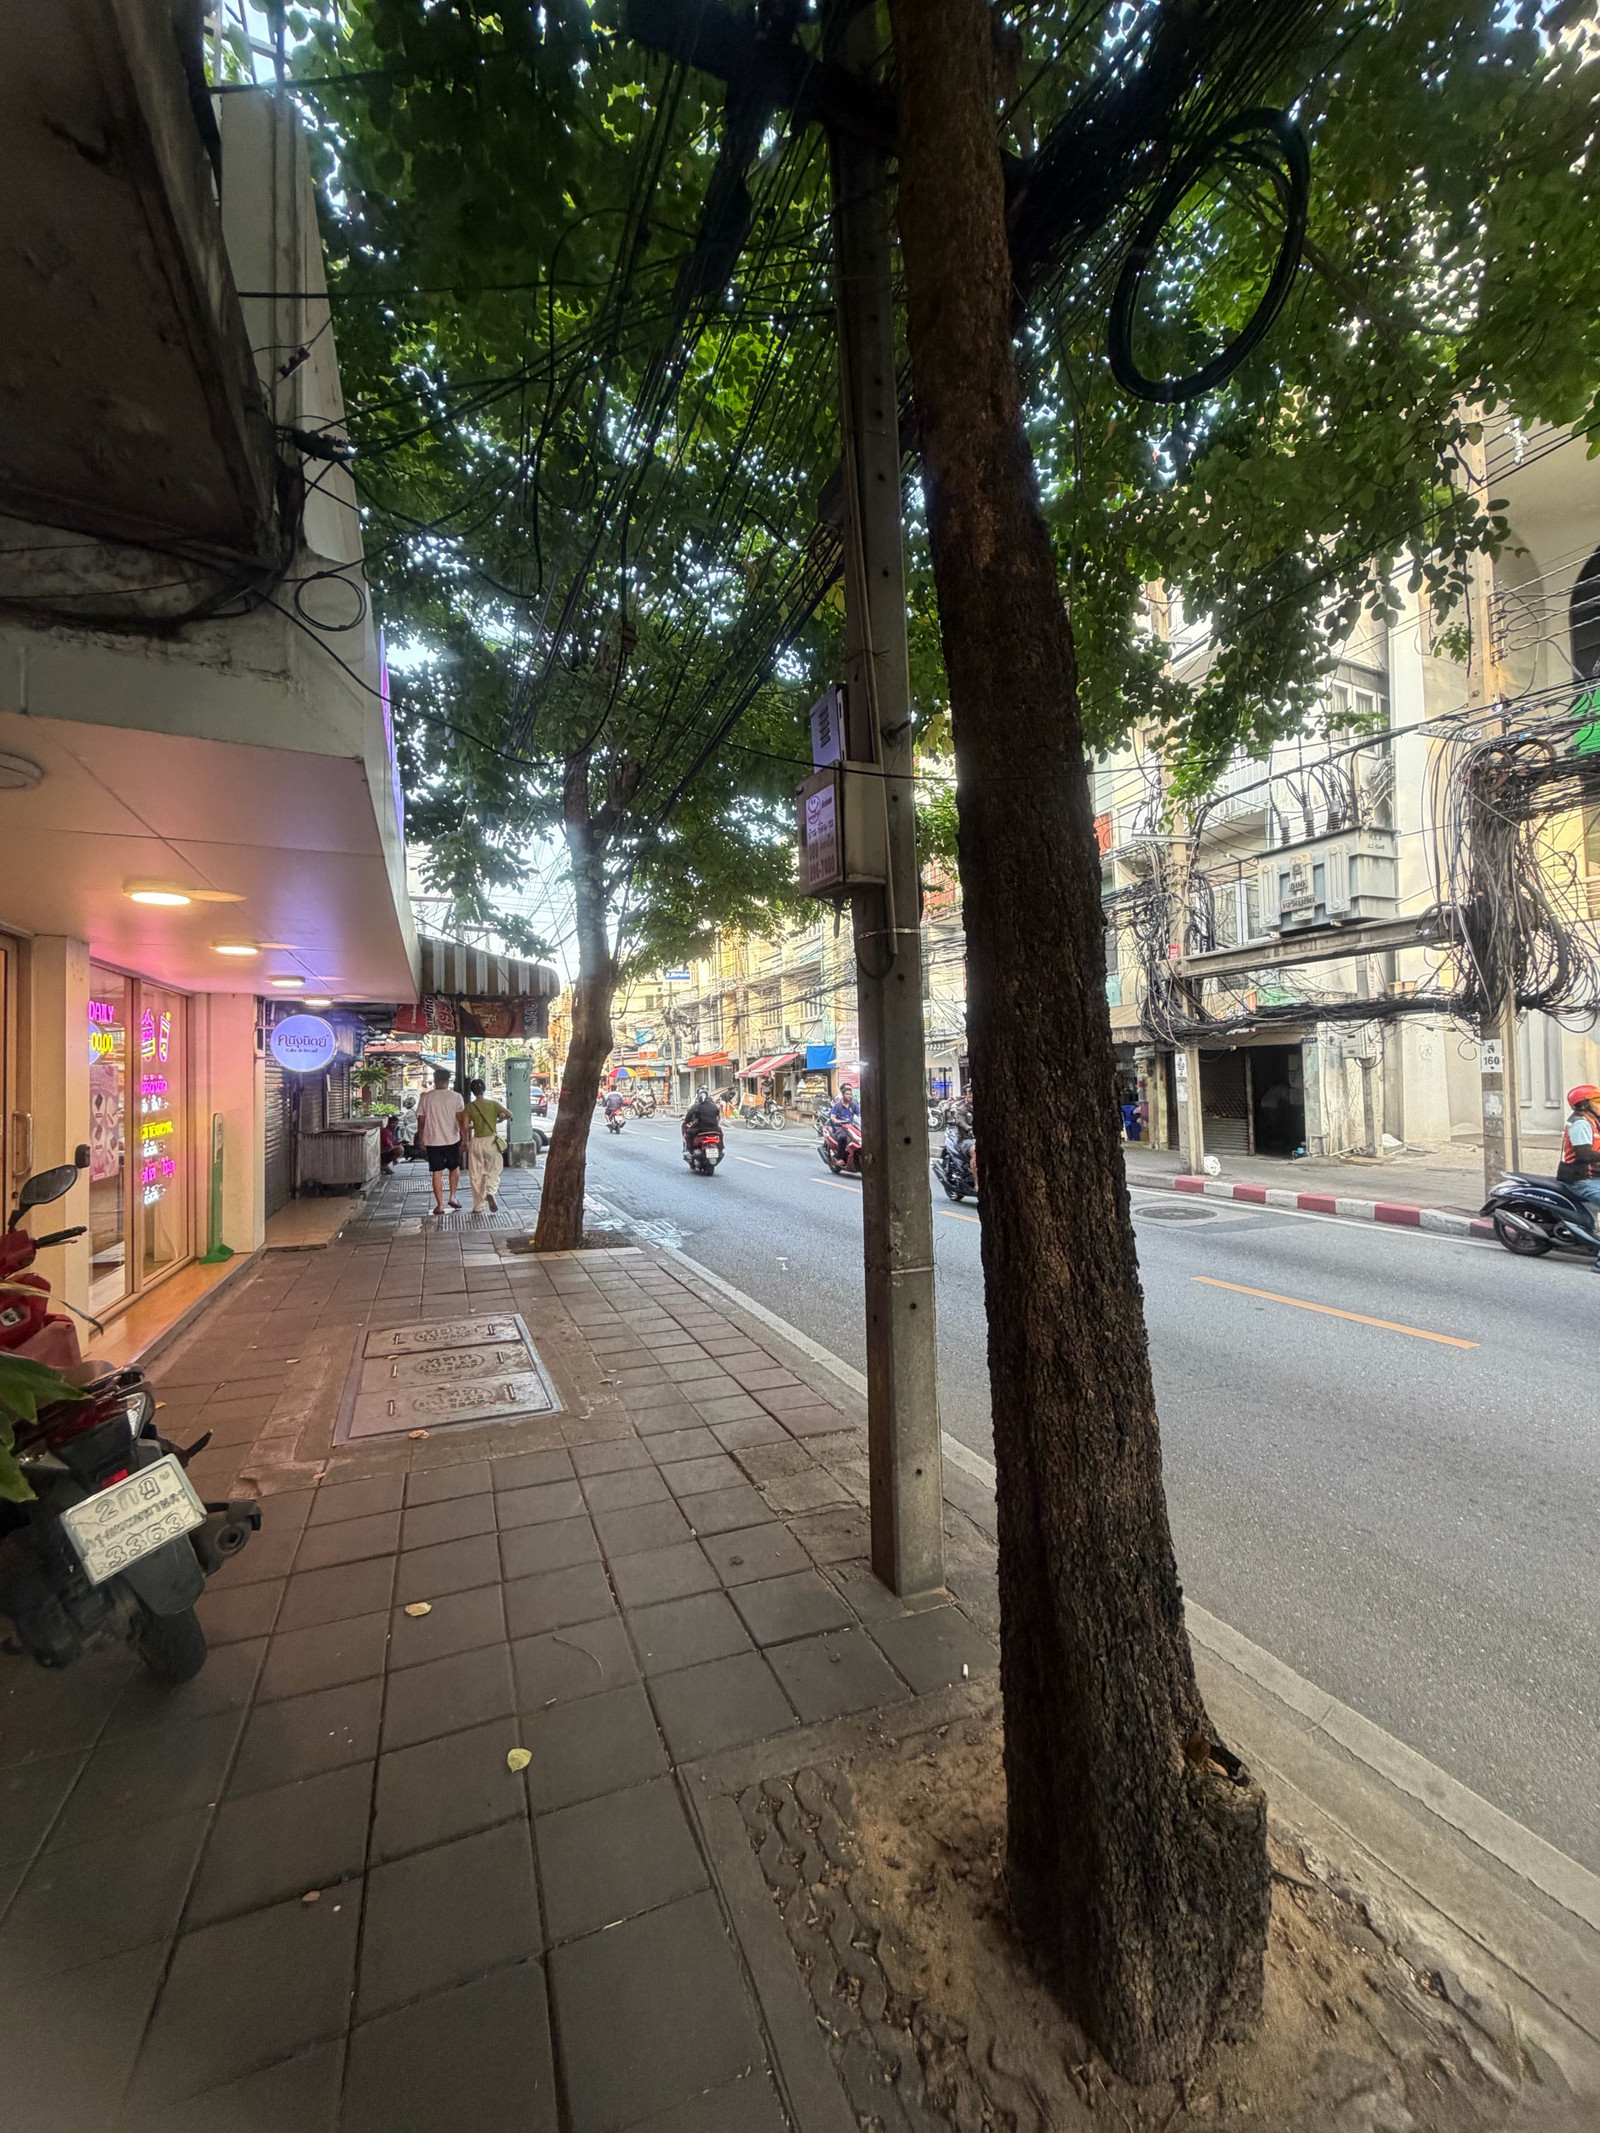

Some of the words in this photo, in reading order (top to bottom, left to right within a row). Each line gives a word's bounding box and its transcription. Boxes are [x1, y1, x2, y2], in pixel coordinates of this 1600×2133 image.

[1290, 881, 1306, 890] 500
[88, 1001, 114, 1024] DAILY
[1483, 1056, 1500, 1065] 160
[106, 1511, 186, 1568] 3363
